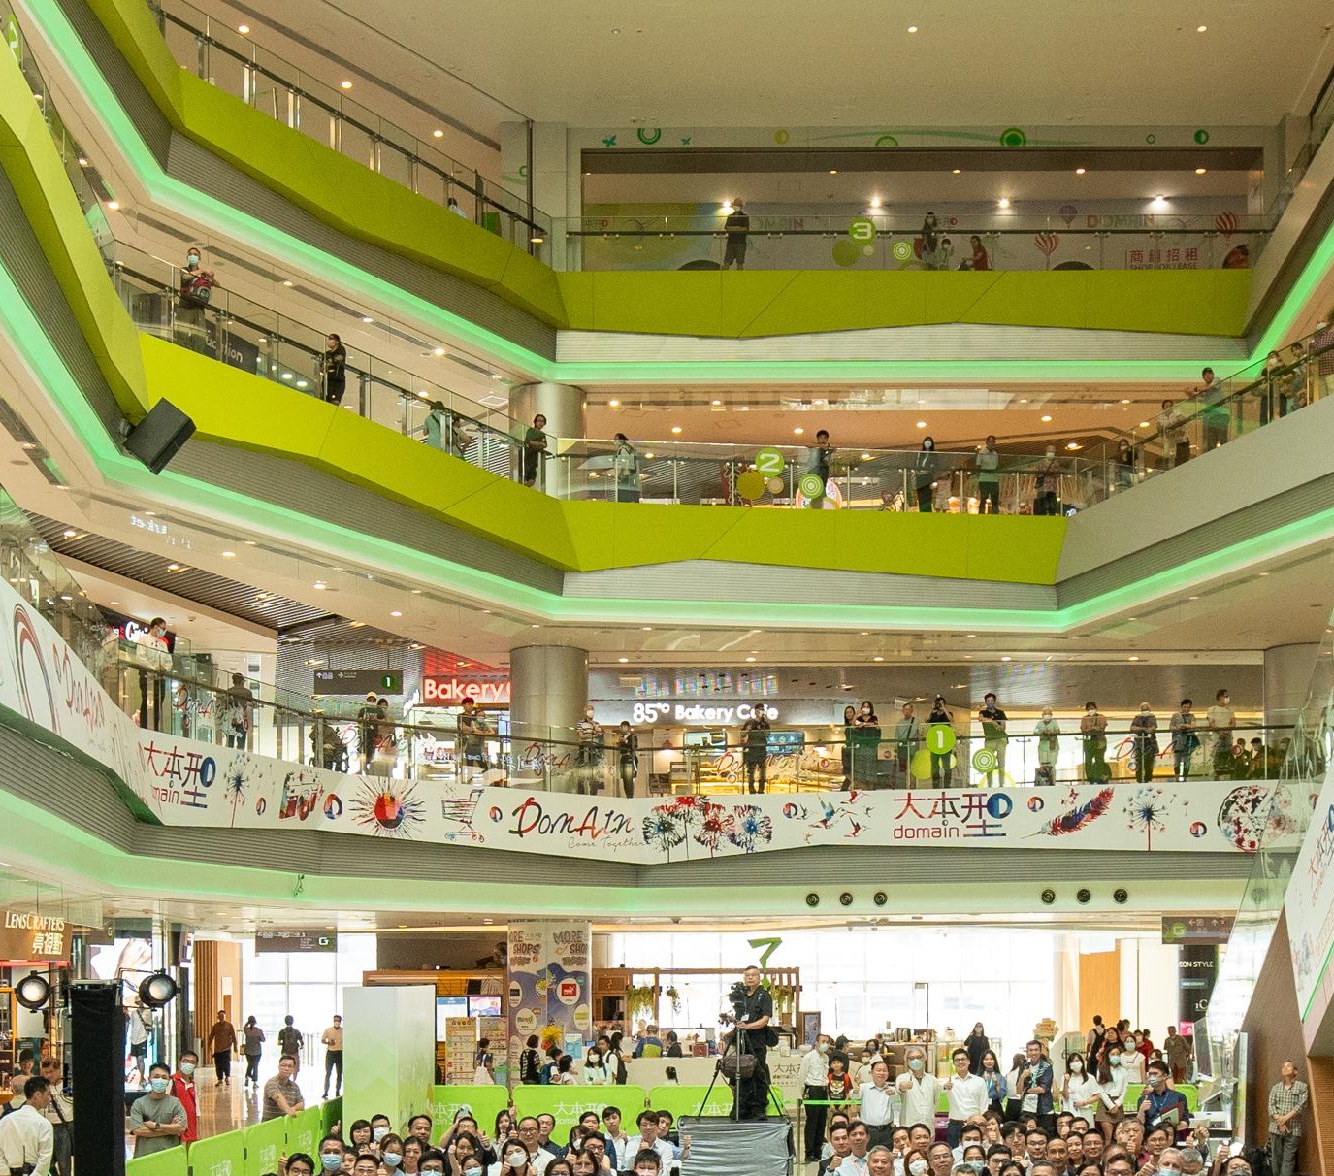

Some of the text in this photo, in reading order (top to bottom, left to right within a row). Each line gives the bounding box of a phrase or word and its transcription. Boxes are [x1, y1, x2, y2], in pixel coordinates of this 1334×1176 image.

[854, 222, 871, 240] 3
[760, 454, 780, 473] 2
[425, 679, 504, 700] Bakery
[675, 703, 733, 723] Bakery
[936, 734, 945, 748] 1
[144, 740, 216, 808] 大本型
[894, 792, 1013, 837] 大本型
[894, 819, 960, 839] domain
